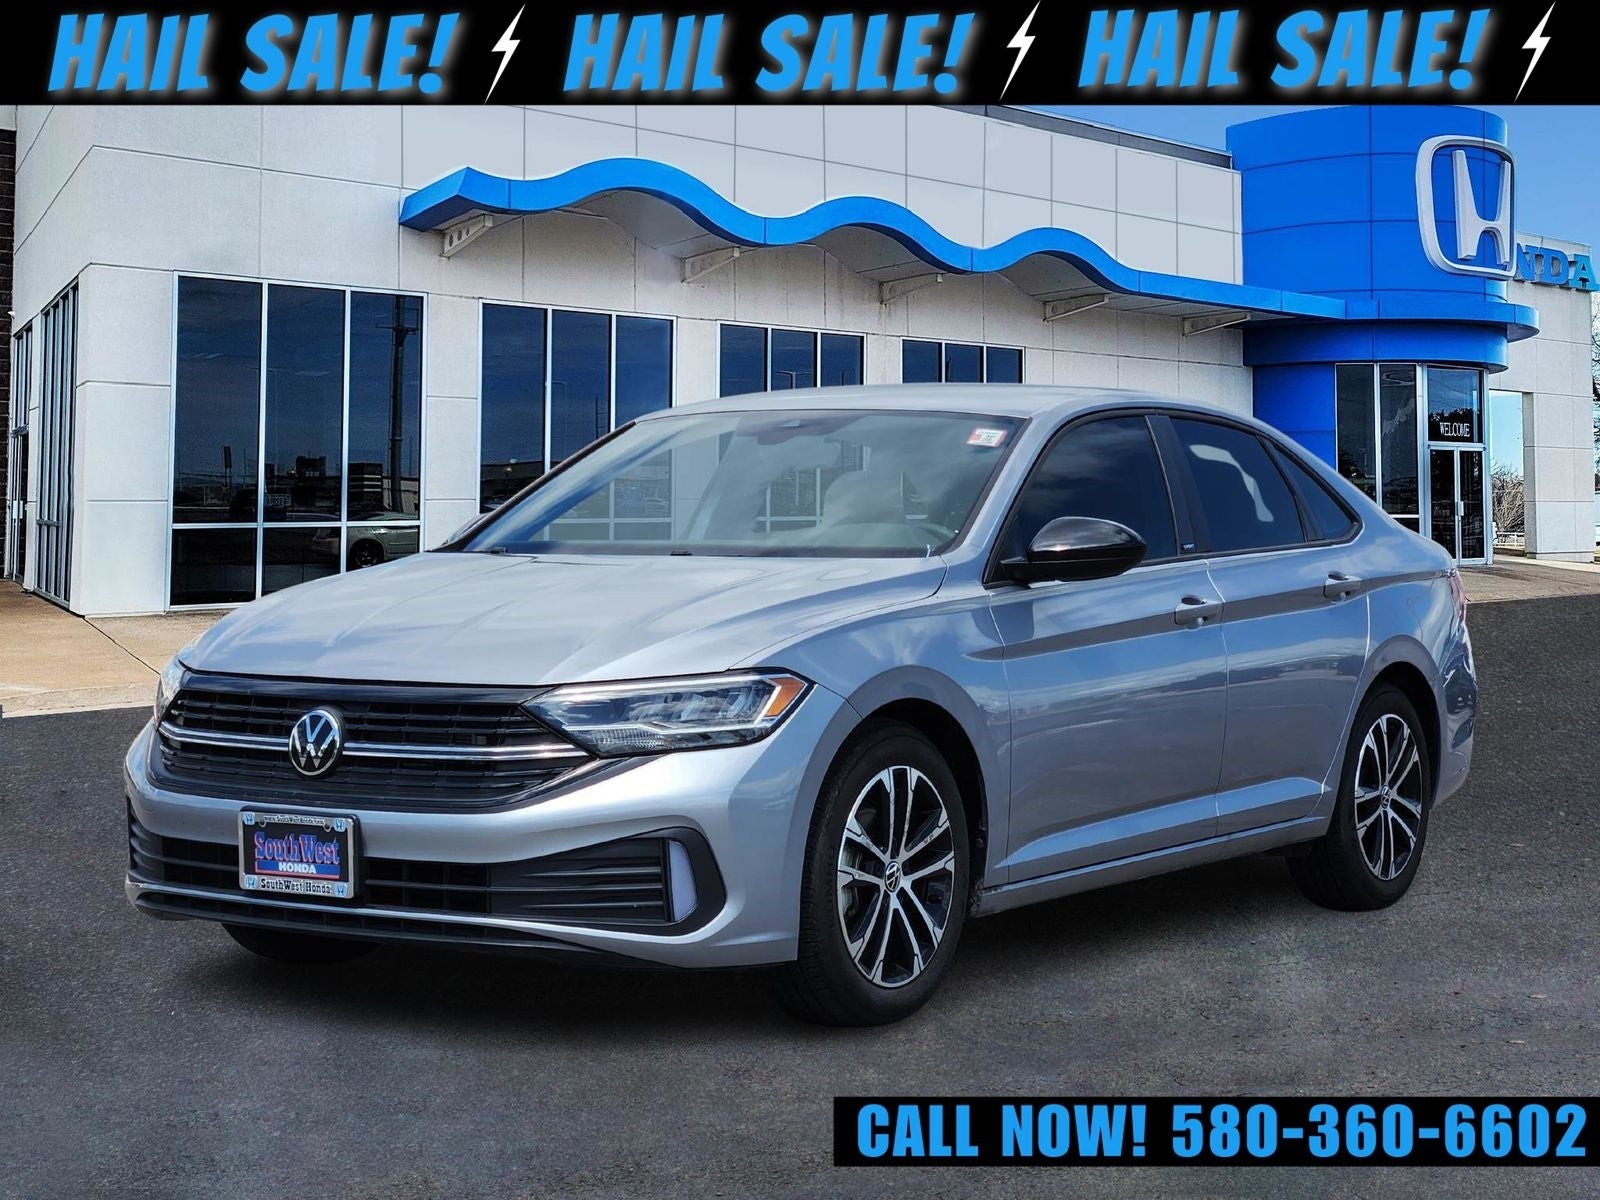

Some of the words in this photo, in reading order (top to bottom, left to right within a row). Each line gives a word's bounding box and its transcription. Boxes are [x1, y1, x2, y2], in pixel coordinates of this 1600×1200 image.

[1514, 242, 1600, 291] NDA
[1439, 421, 1471, 438] WELCOME
[254, 831, 341, 865] SouthWest
[278, 861, 317, 874] HONDA
[260, 878, 304, 892] SouthWest
[305, 881, 331, 894] Honda
